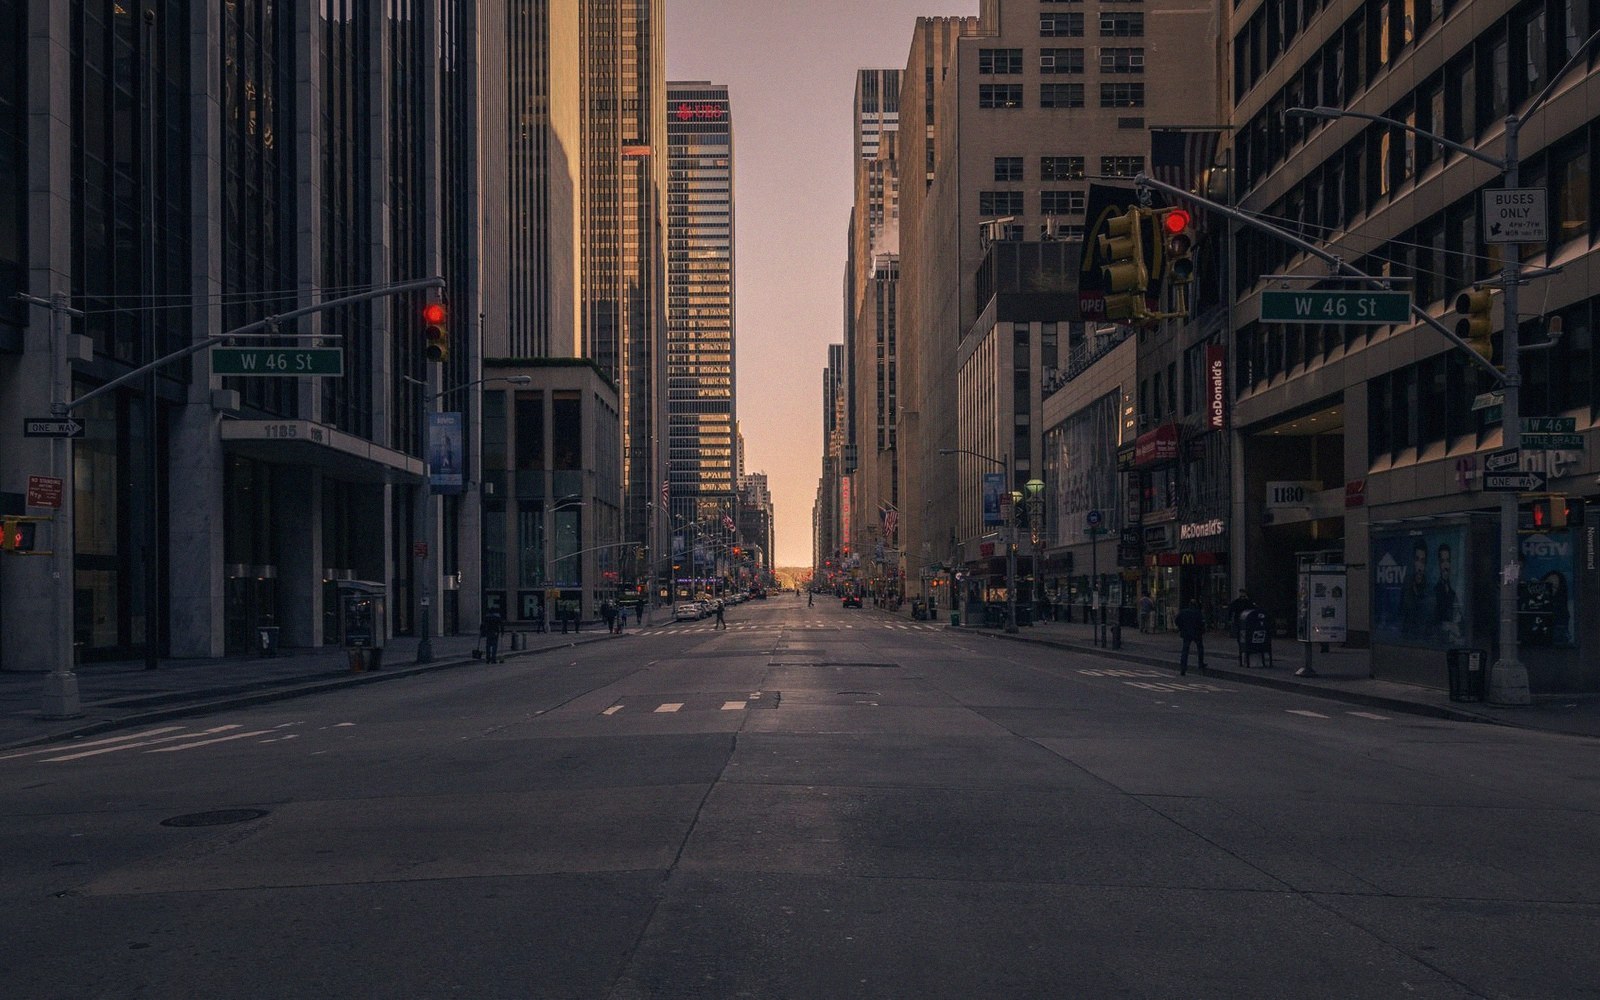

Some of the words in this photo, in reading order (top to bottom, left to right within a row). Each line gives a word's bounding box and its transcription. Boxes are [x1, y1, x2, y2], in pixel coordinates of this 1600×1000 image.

[695, 104, 722, 118] UBS
[1496, 193, 1534, 205] BUSES
[1500, 207, 1530, 219] ONLY
[1295, 297, 1312, 316] W
[1322, 297, 1347, 316] 46
[1357, 298, 1376, 317] St
[241, 353, 256, 370] W
[266, 353, 287, 370] 46
[296, 353, 313, 370] St
[1212, 360, 1222, 427] McDonald's
[32, 423, 50, 432] ONE
[58, 423, 77, 432] WAY
[265, 425, 296, 438] 1185
[1531, 419, 1540, 431] W
[1545, 419, 1562, 432] 46
[1520, 436, 1548, 445] LITTLE
[1552, 436, 1583, 445] BRAZIL
[1491, 477, 1511, 486] ONE
[1519, 477, 1537, 486] WAY
[1273, 487, 1305, 503] 1180
[1180, 519, 1224, 540] McDonald's
[1521, 541, 1570, 557] HGTV
[1376, 565, 1408, 584] HGTV
